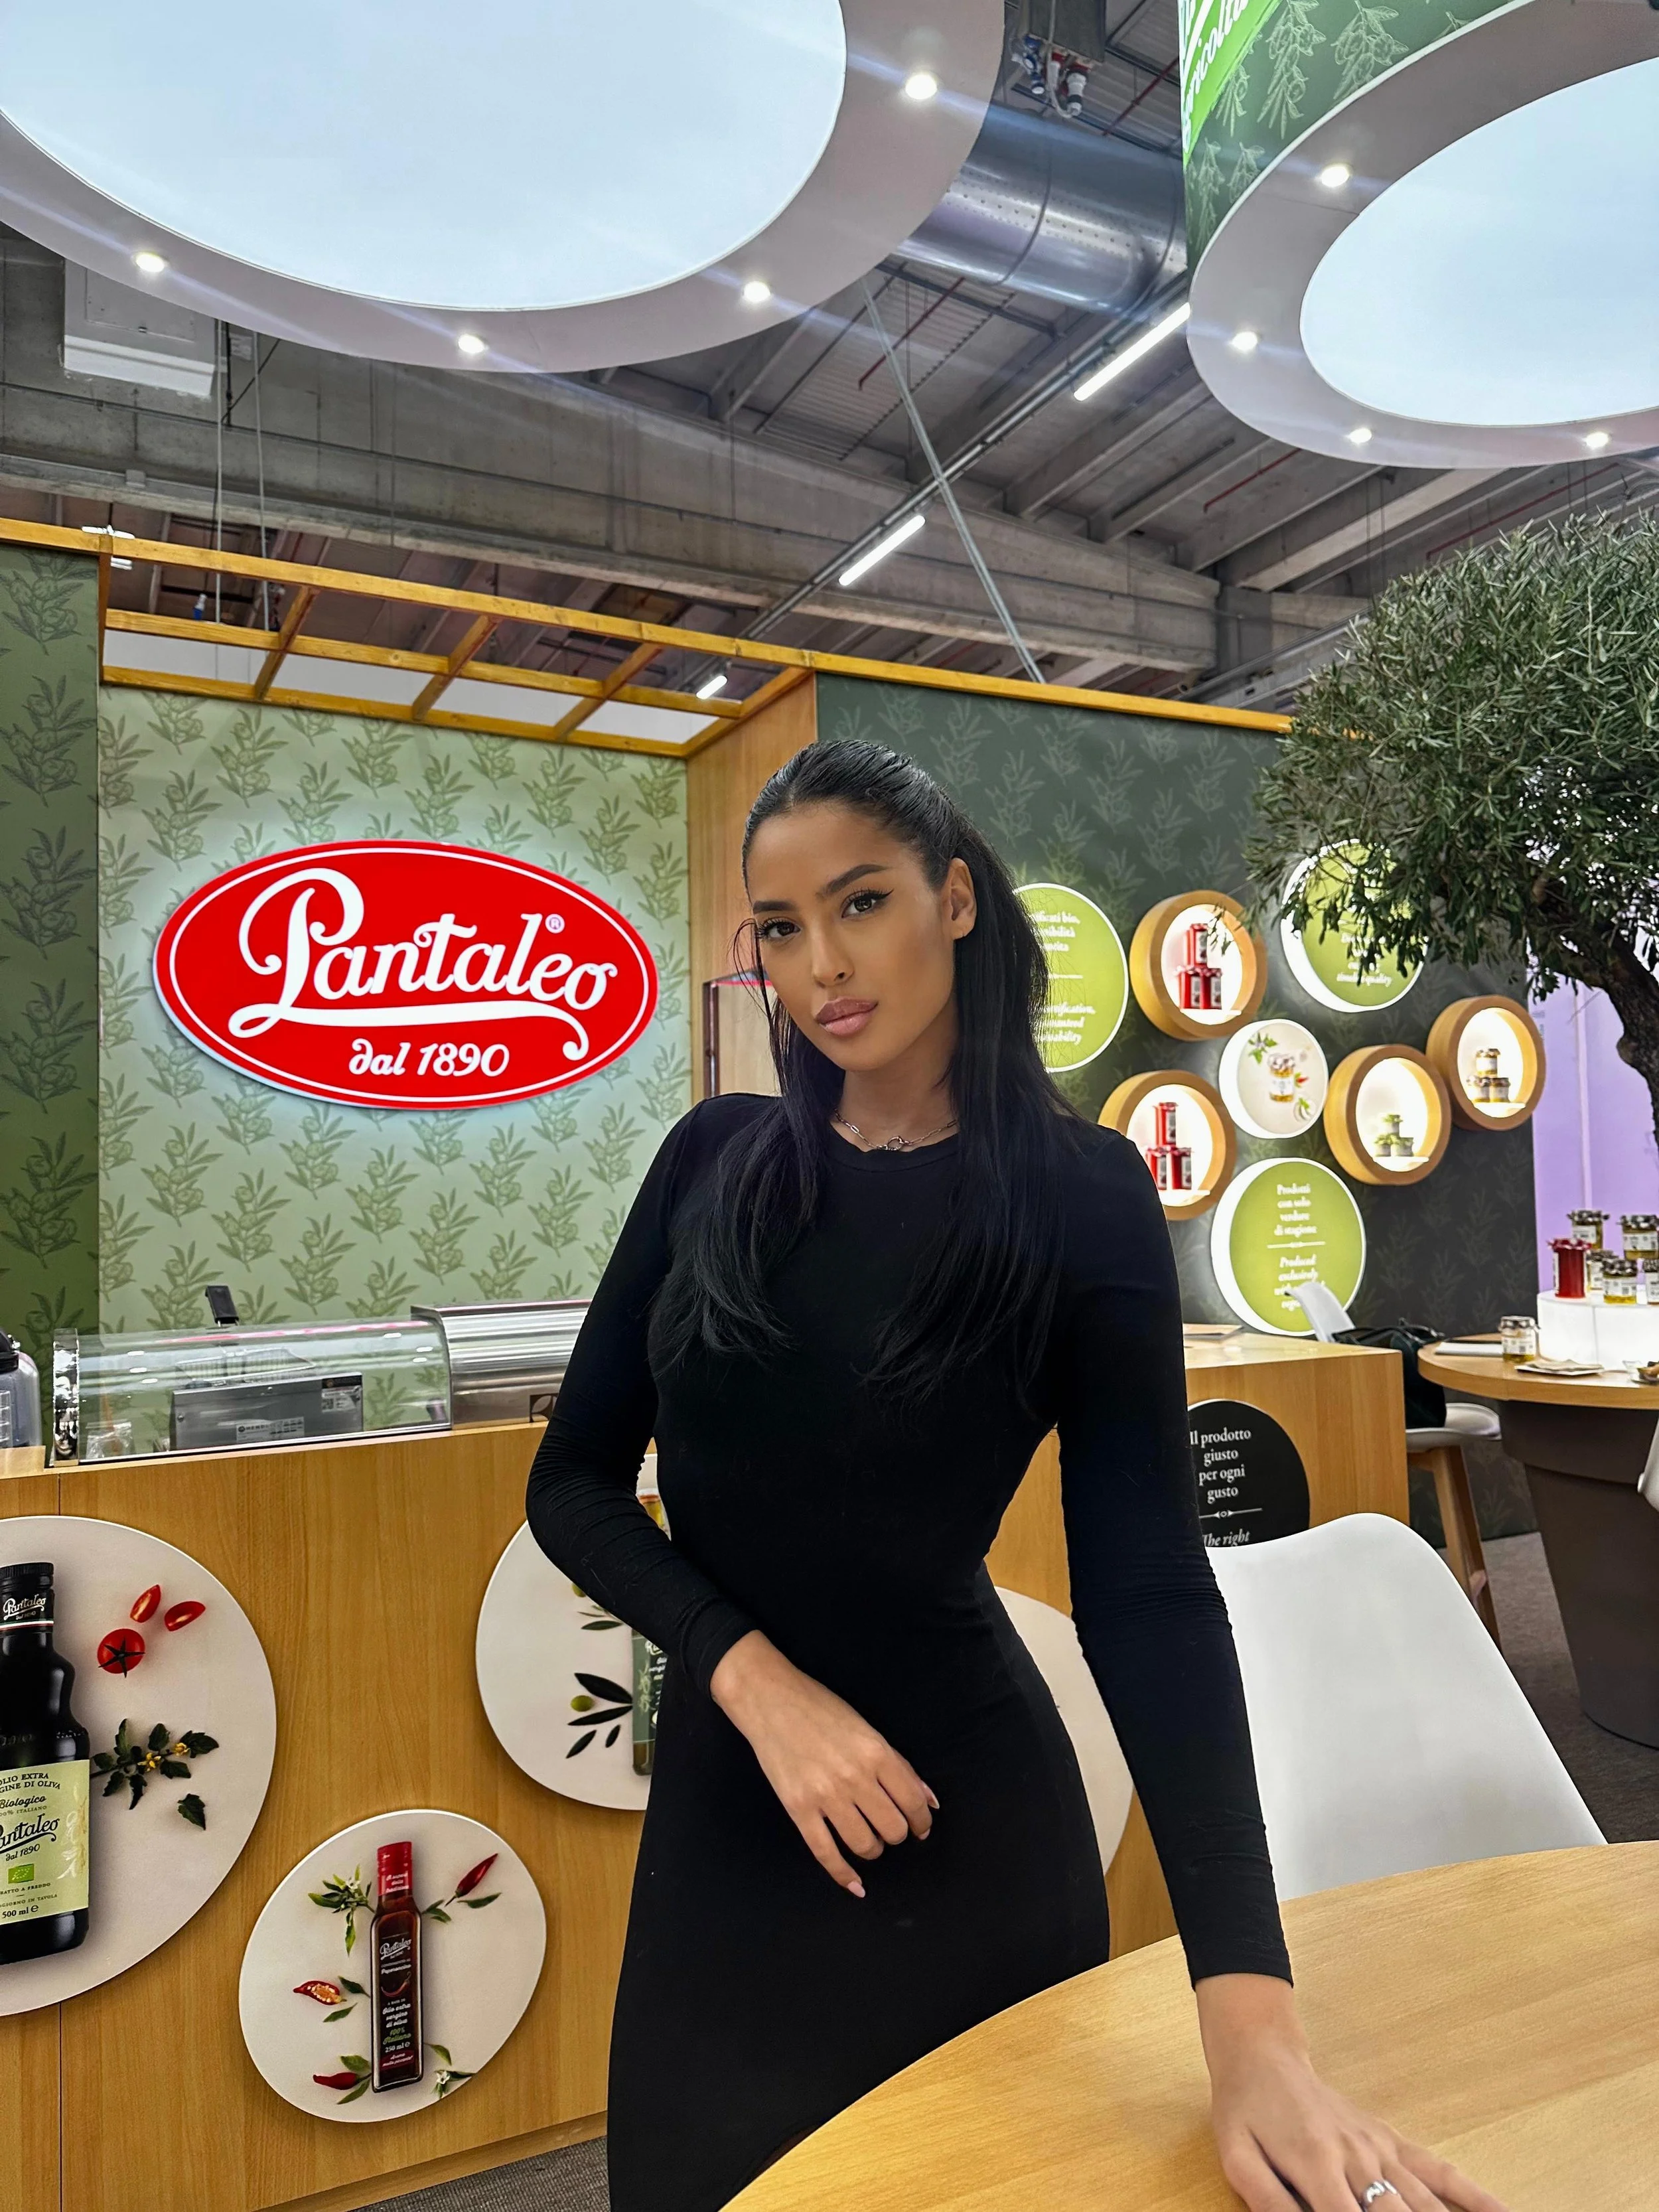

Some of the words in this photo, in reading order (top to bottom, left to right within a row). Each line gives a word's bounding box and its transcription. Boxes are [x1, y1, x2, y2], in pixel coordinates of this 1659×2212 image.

[348, 1038, 411, 1076] dal
[417, 1043, 510, 1077] 1890
[1190, 1430, 1198, 1445] Il
[1200, 1427, 1252, 1448] prodotto
[1204, 1448, 1239, 1467] giusto
[1198, 1471, 1217, 1486] per
[1220, 1463, 1246, 1483] ogni
[1207, 1487, 1239, 1505] gusto
[1222, 1528, 1250, 1547] right
[3, 1594, 46, 1620] Pantaleo
[37, 1781, 60, 1789] OLIVA
[17, 1805, 47, 1814] ITALIANO
[5, 1851, 18, 1861] dal
[20, 1844, 40, 1857] 1890
[2, 1910, 17, 1919] 500
[19, 1907, 29, 1915] ml
